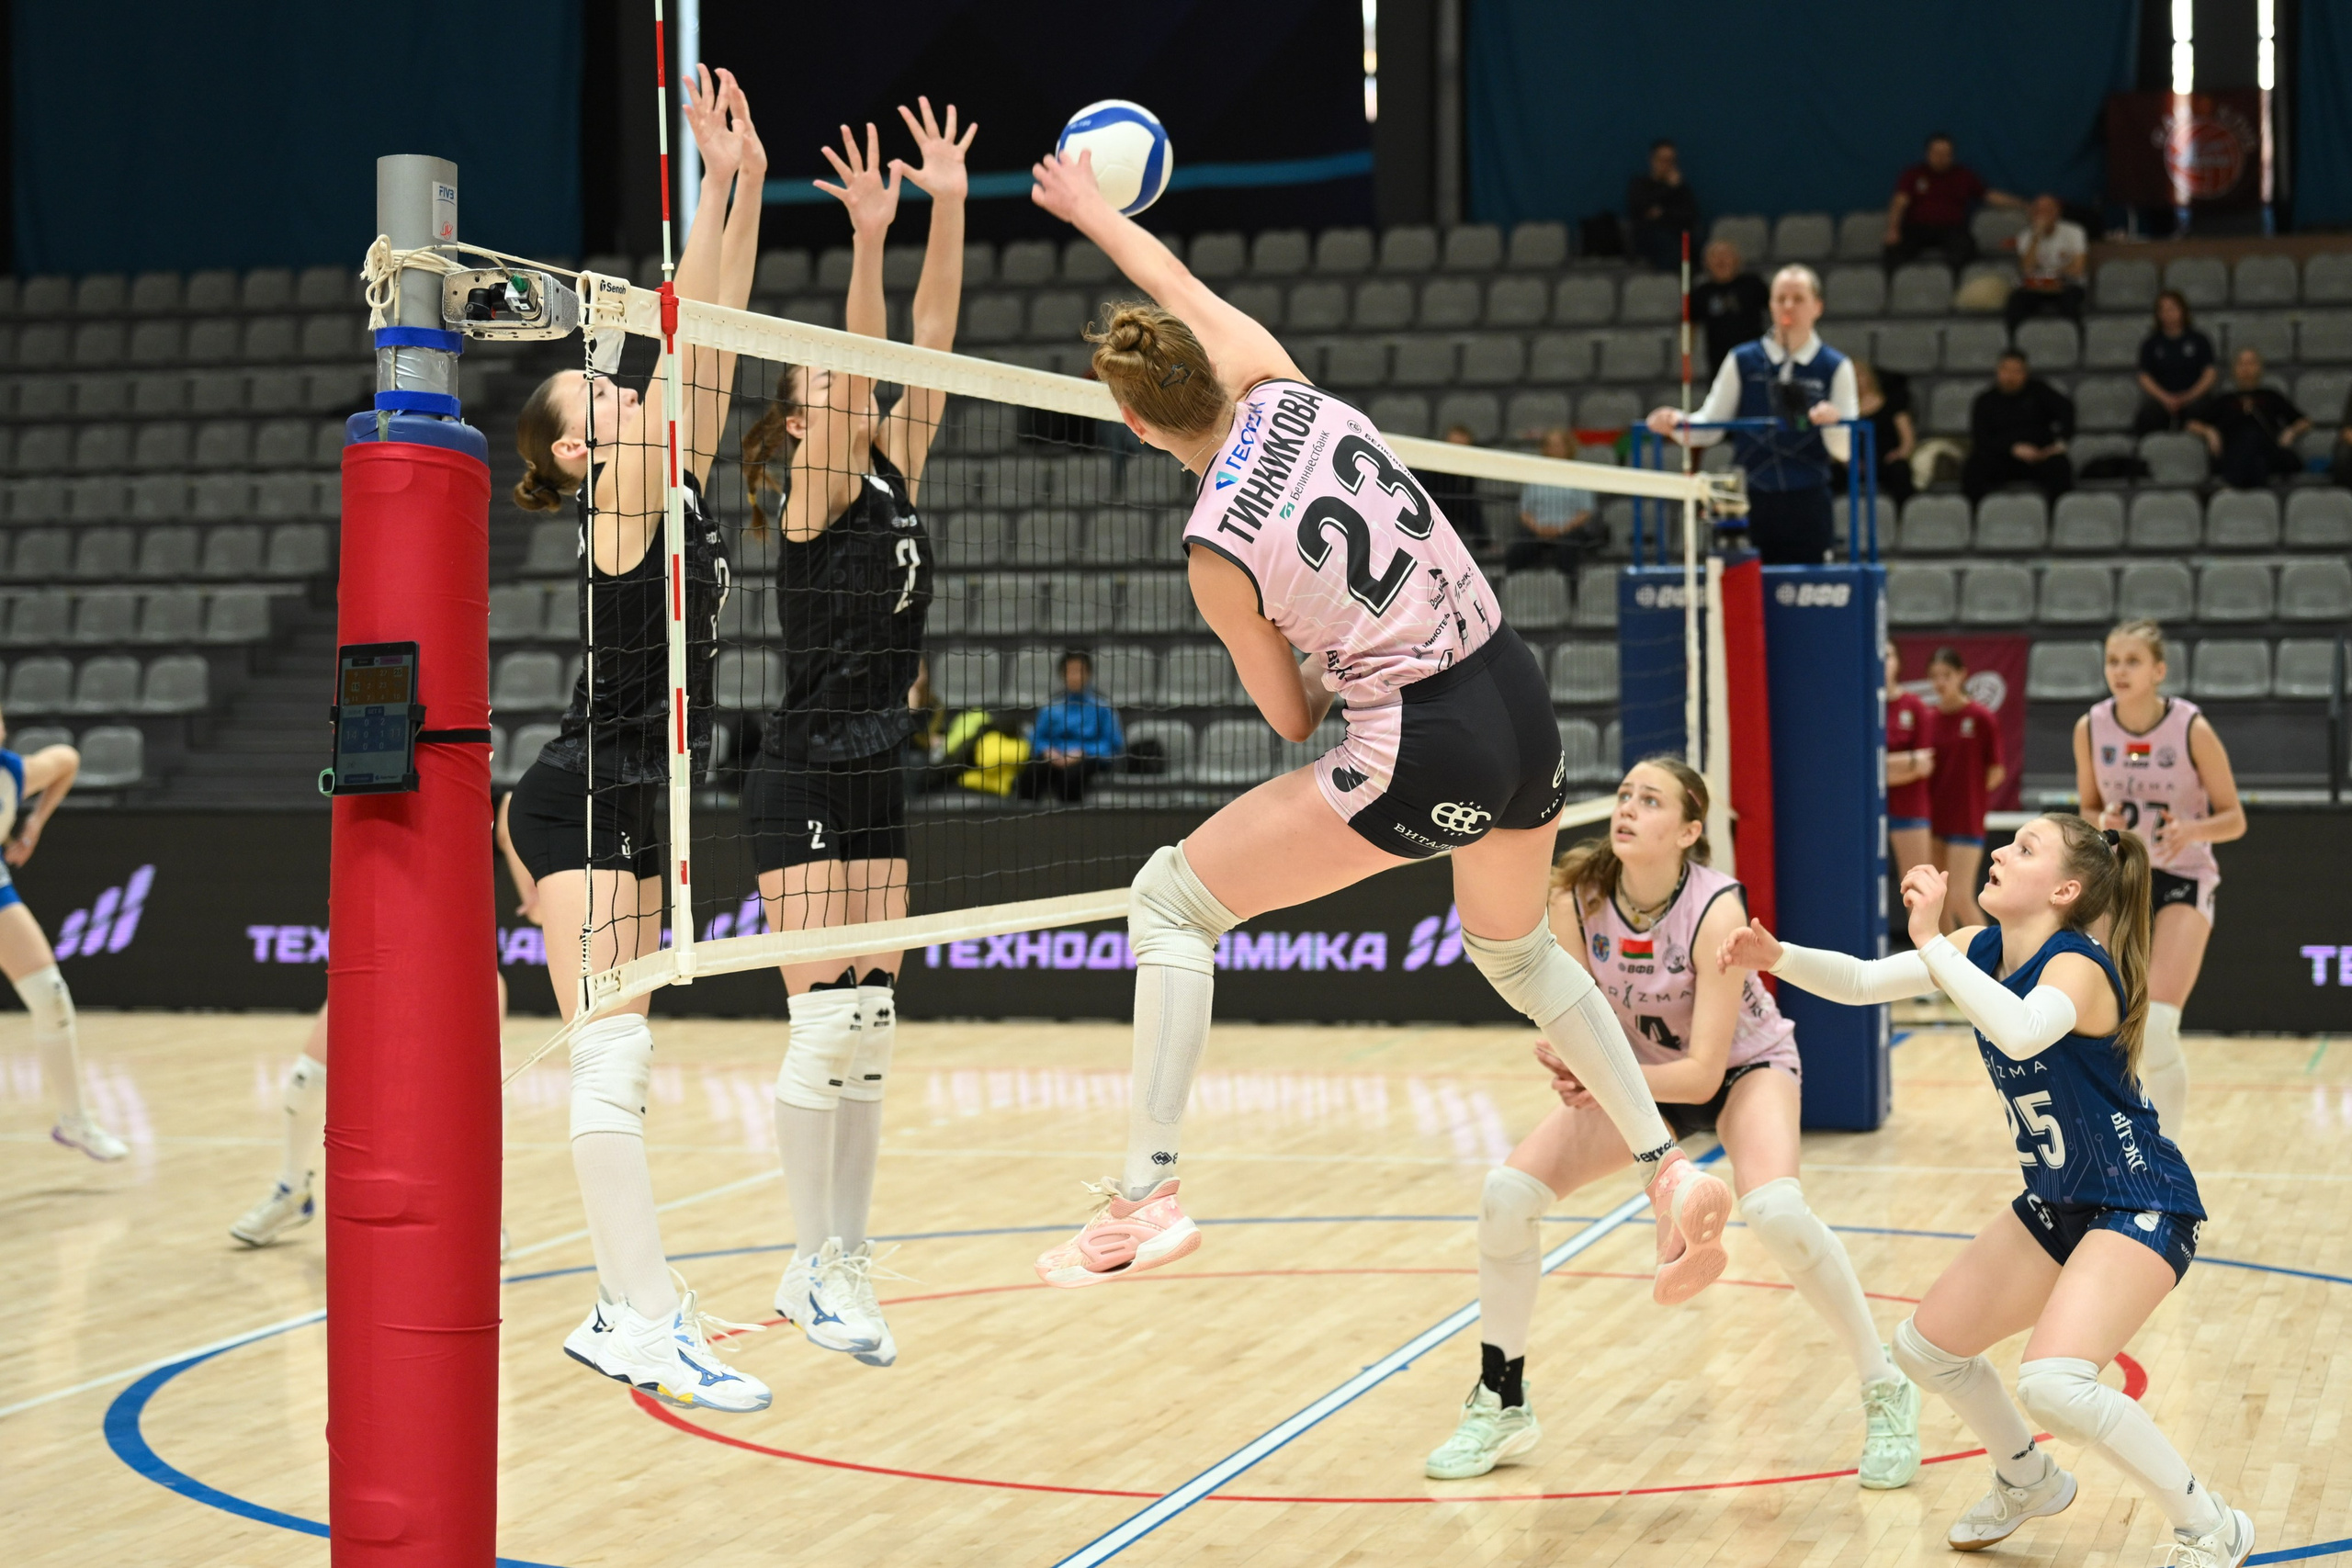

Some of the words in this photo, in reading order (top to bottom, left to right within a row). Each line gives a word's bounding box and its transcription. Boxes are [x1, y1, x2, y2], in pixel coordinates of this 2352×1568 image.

[605, 280, 627, 295] Senoh
[1290, 430, 1330, 502] Белинвестбанк
[1296, 434, 1435, 618] 23
[1421, 613, 1450, 649] МИНОТЕЬ
[925, 930, 1387, 971] ТЕХНОДАМИКА
[1996, 1088, 2066, 1170] 25
